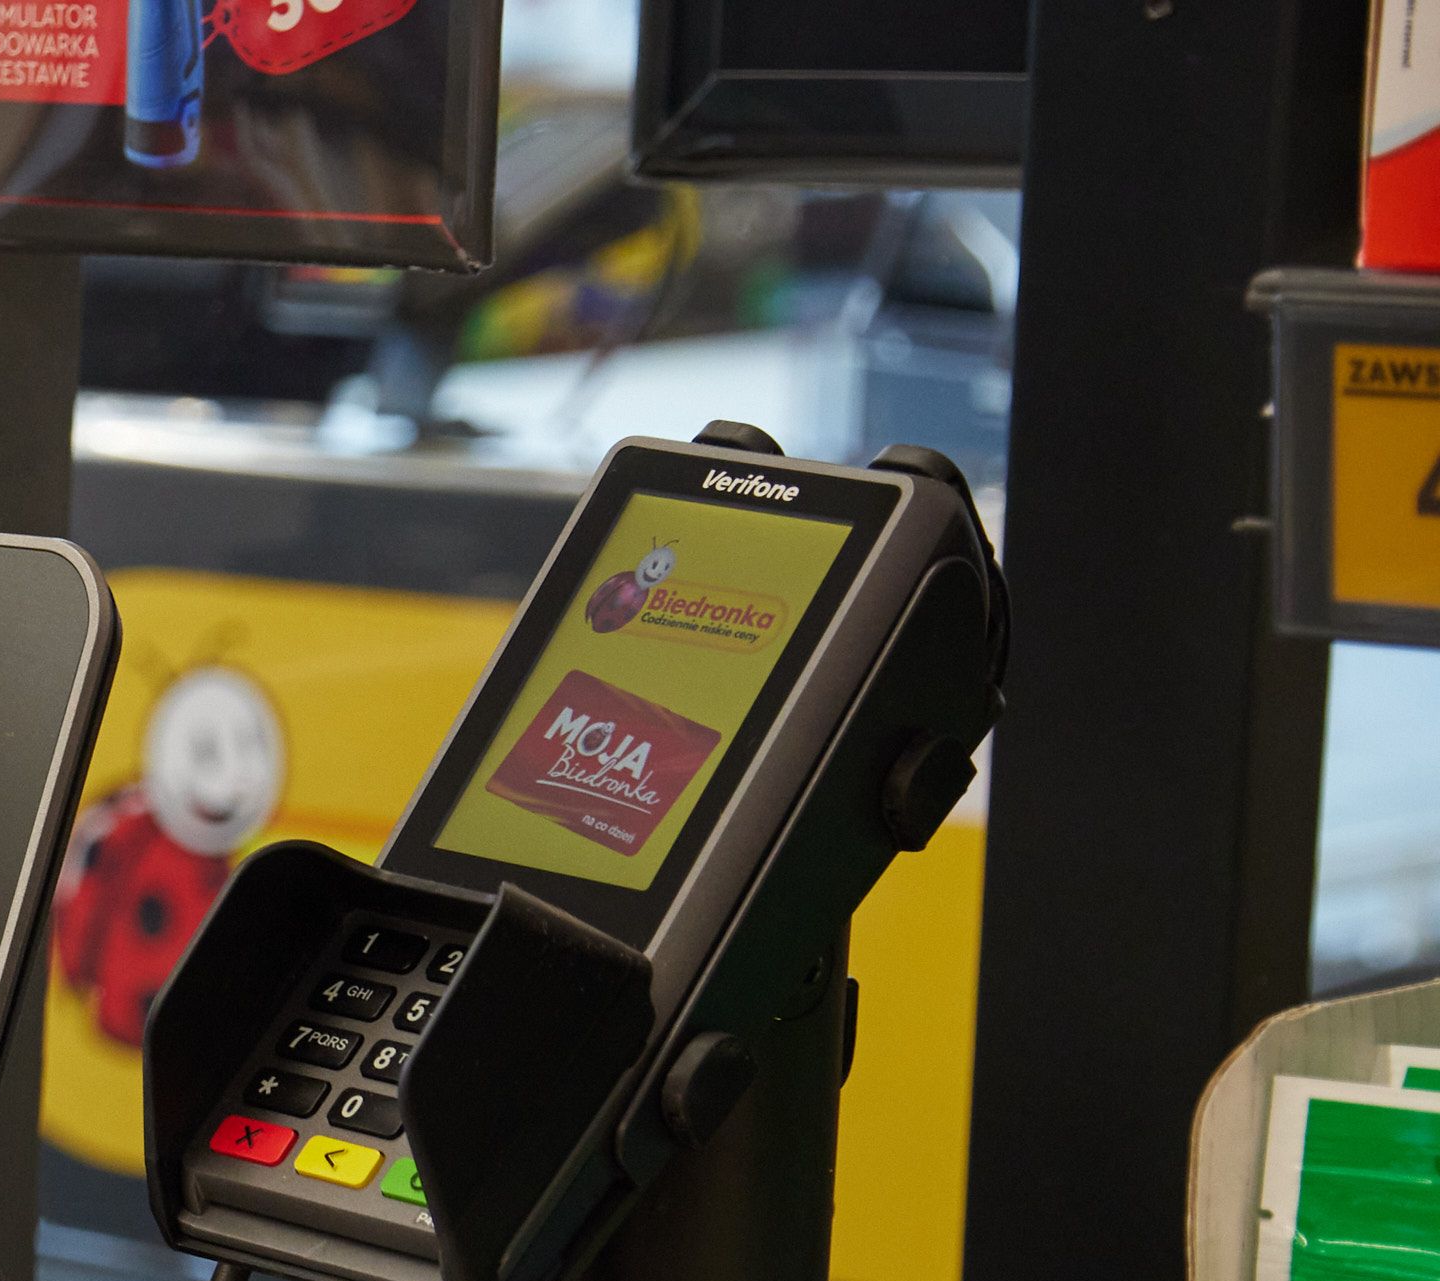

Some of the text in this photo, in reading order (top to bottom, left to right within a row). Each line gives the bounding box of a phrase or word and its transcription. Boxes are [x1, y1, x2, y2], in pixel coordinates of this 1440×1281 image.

[702, 468, 801, 503] Verifone
[647, 588, 777, 631] Biedronka
[640, 611, 700, 633] Codziennie
[543, 706, 653, 780] MOJA
[546, 742, 661, 806] Biedronka
[581, 814, 595, 827] na
[594, 820, 609, 832] co
[361, 931, 381, 954] 1
[439, 950, 464, 974] 2
[322, 979, 375, 1002] 4 GHI
[405, 999, 431, 1023] 5
[288, 1025, 350, 1052] 7 PQRS
[372, 1046, 397, 1070] 8
[340, 1094, 365, 1119] 0
